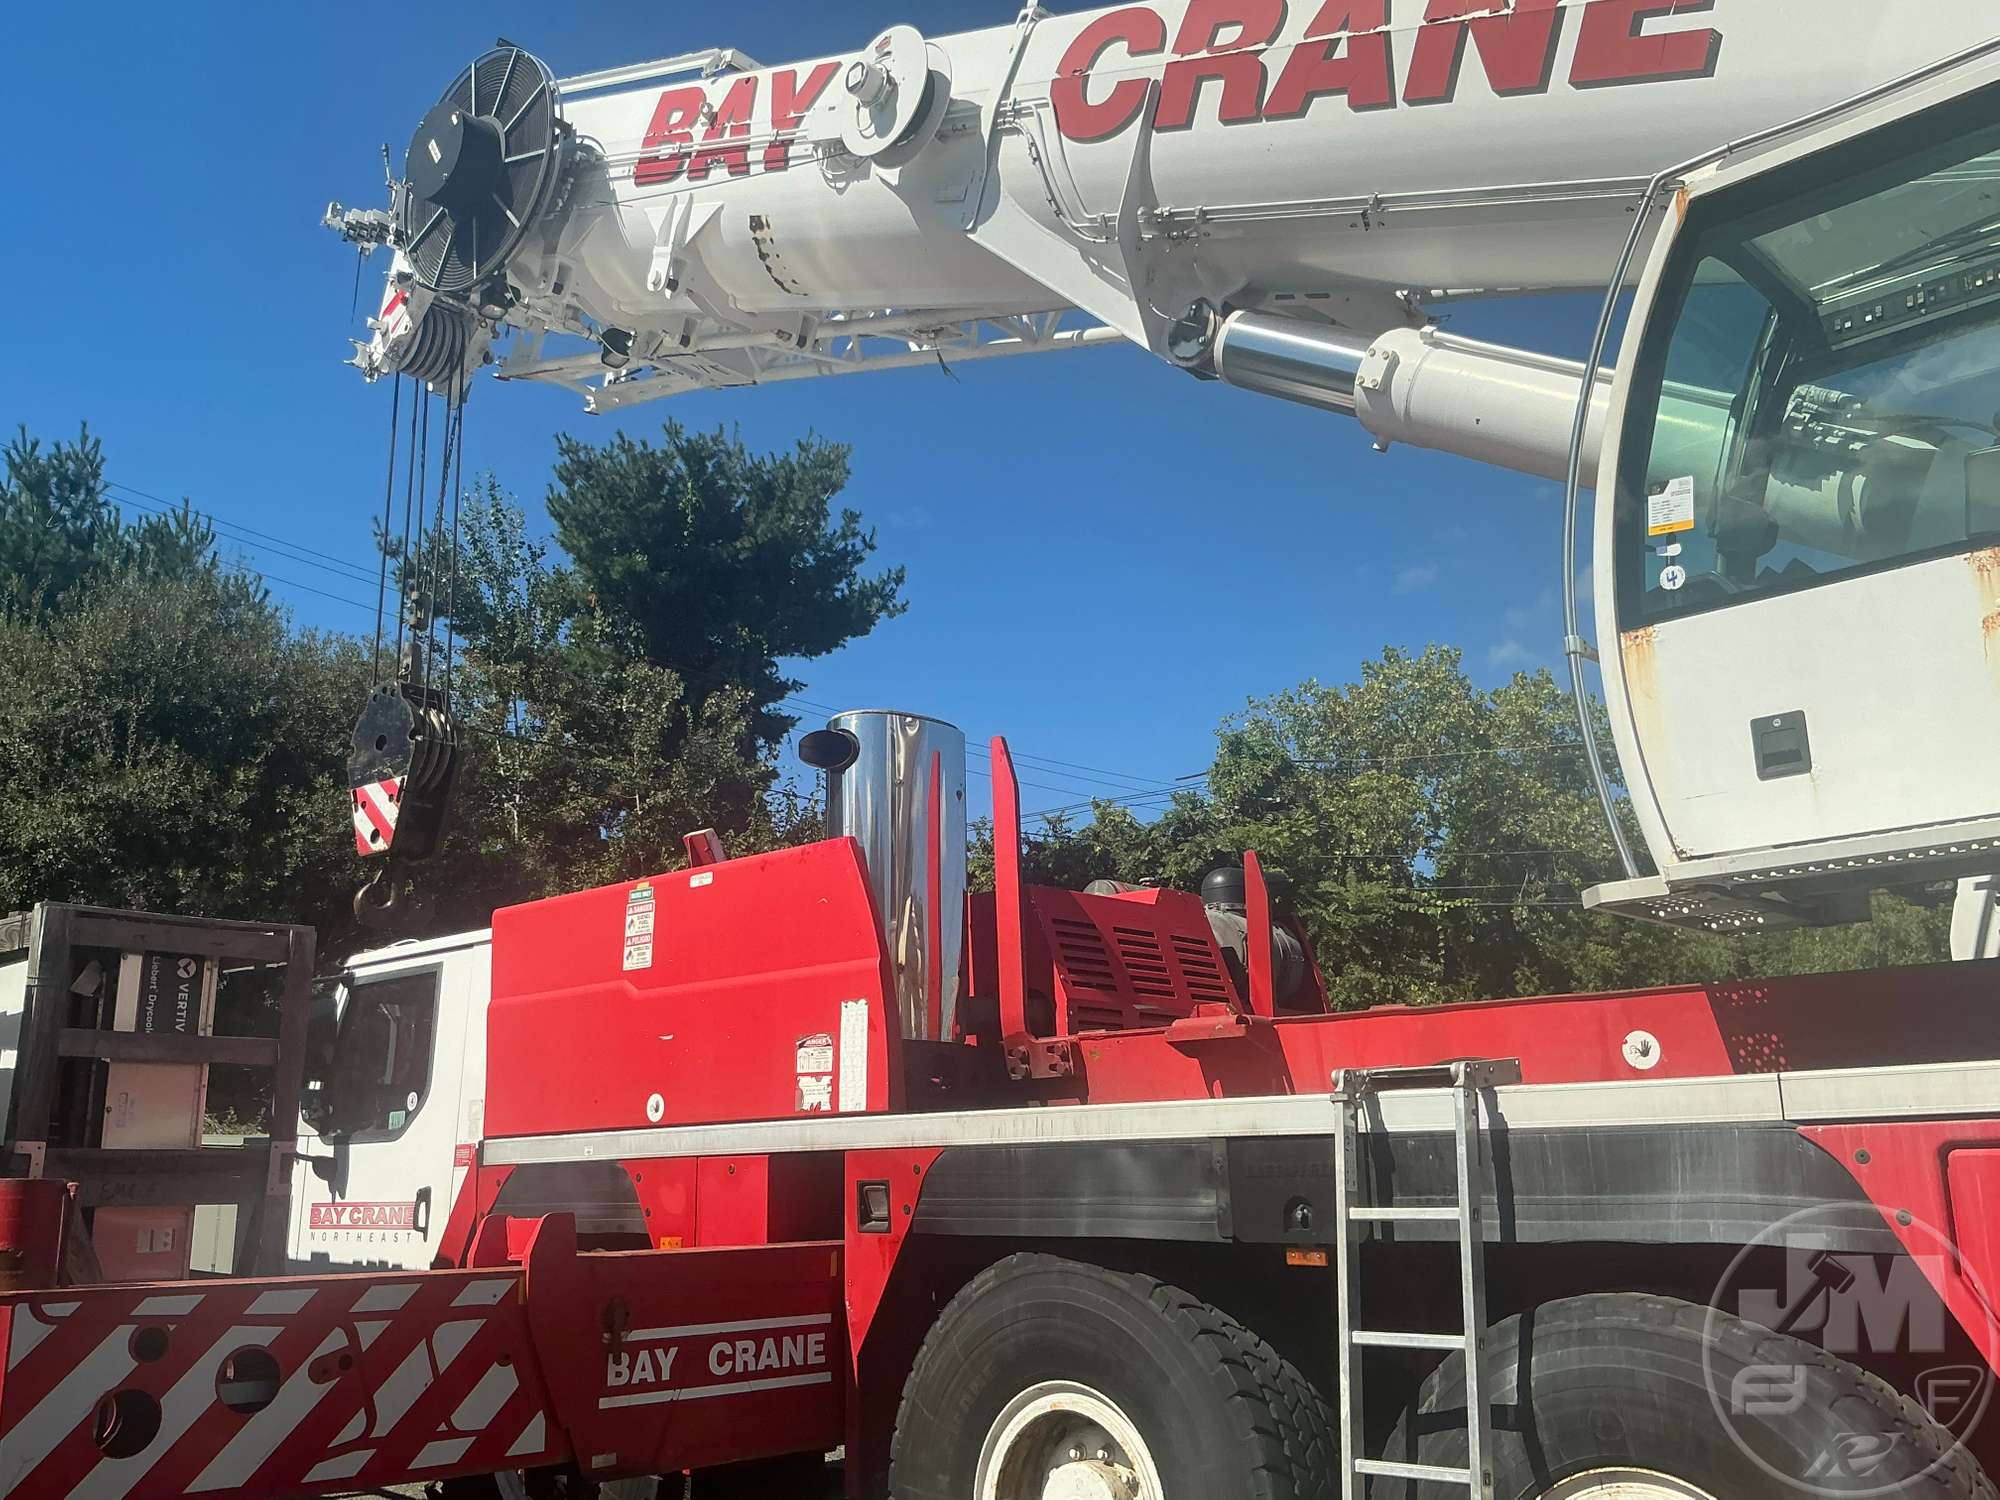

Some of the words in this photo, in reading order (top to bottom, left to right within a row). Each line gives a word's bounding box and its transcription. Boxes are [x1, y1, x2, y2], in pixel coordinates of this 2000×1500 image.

[633, 61, 843, 187] BAY
[1050, 0, 1721, 144] CRANE
[145, 994, 158, 1034] Drycool
[174, 983, 190, 1033] VERTIV
[309, 1206, 347, 1225] BAY
[348, 1206, 415, 1225] CRANE
[310, 1231, 412, 1243] NORTHEAST
[606, 1347, 679, 1387] BAY
[708, 1332, 827, 1377] CRANE
